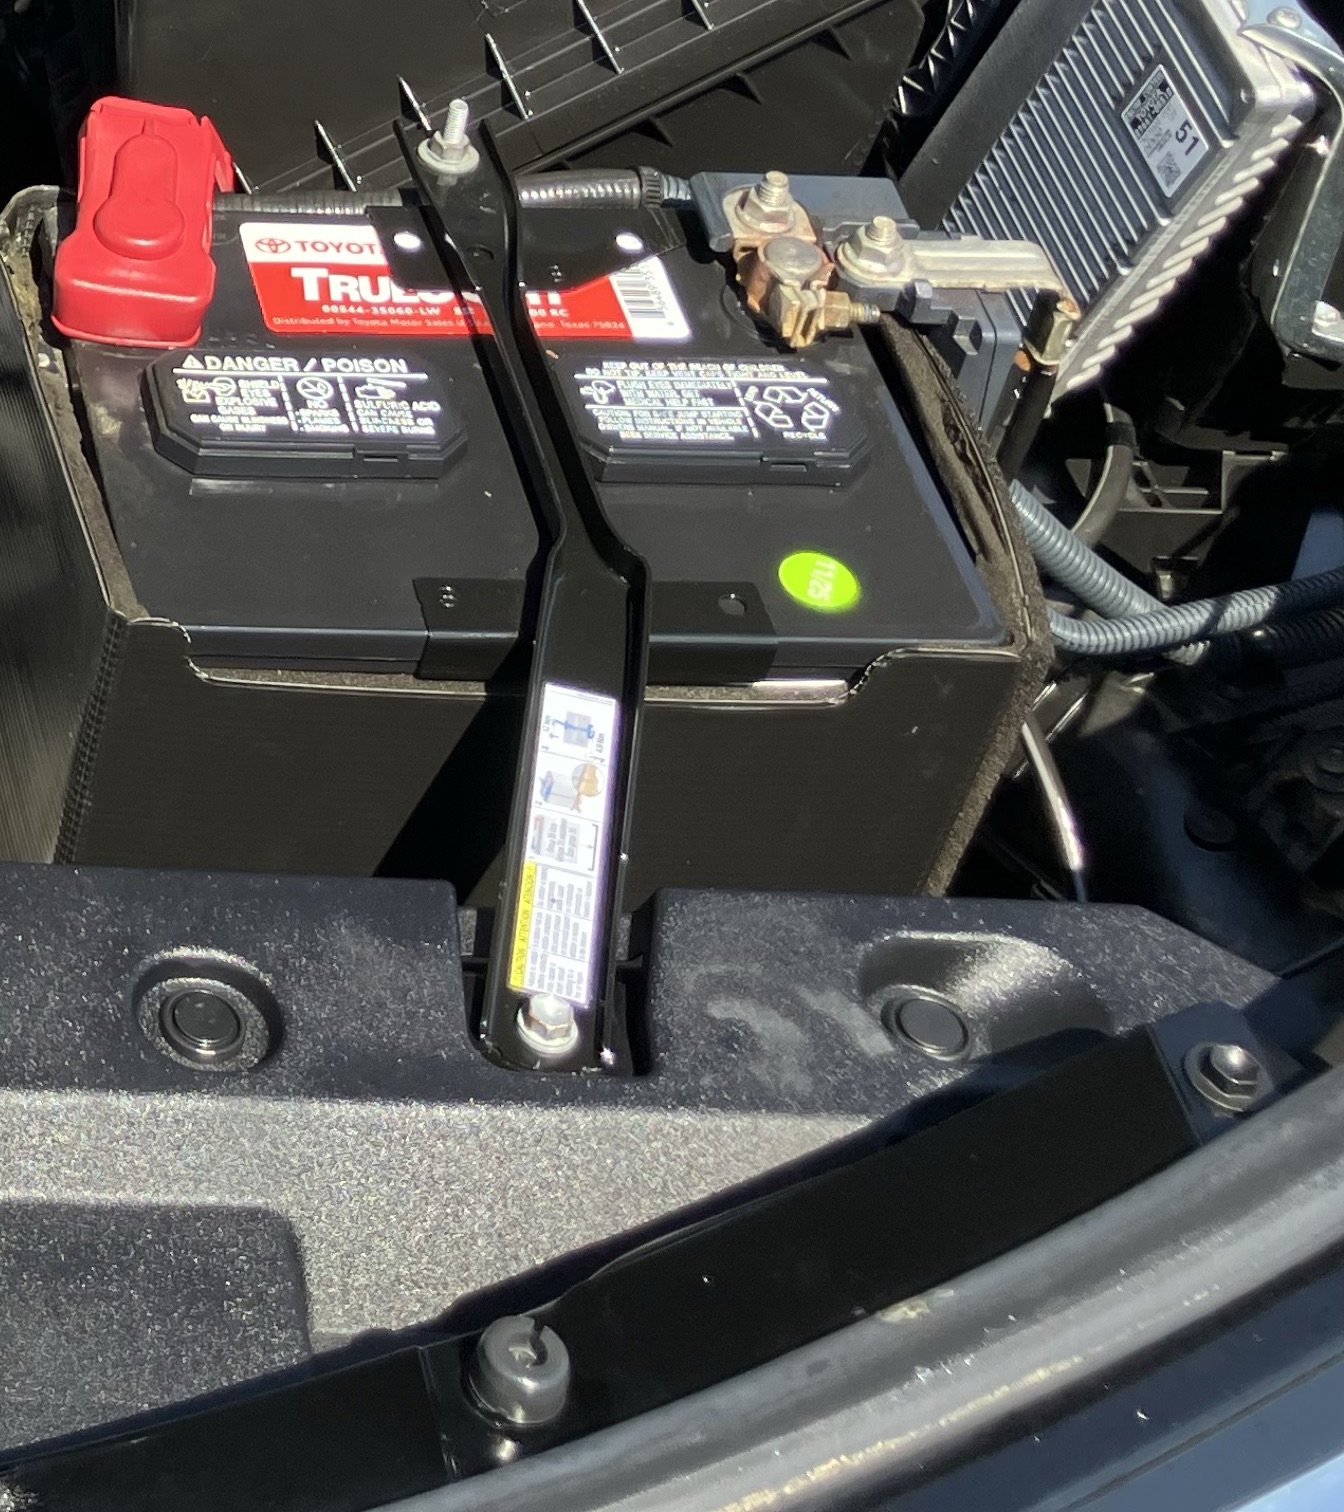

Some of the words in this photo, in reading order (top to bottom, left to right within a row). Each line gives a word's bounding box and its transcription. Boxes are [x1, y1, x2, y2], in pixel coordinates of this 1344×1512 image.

[294, 240, 384, 255] TOYOT
[204, 355, 300, 372] DANGER
[321, 357, 408, 373] POISON
[215, 397, 279, 407] EXPLOSIVE
[307, 399, 328, 409] NO
[354, 399, 410, 411] SULFURIC
[412, 401, 441, 411] ACID
